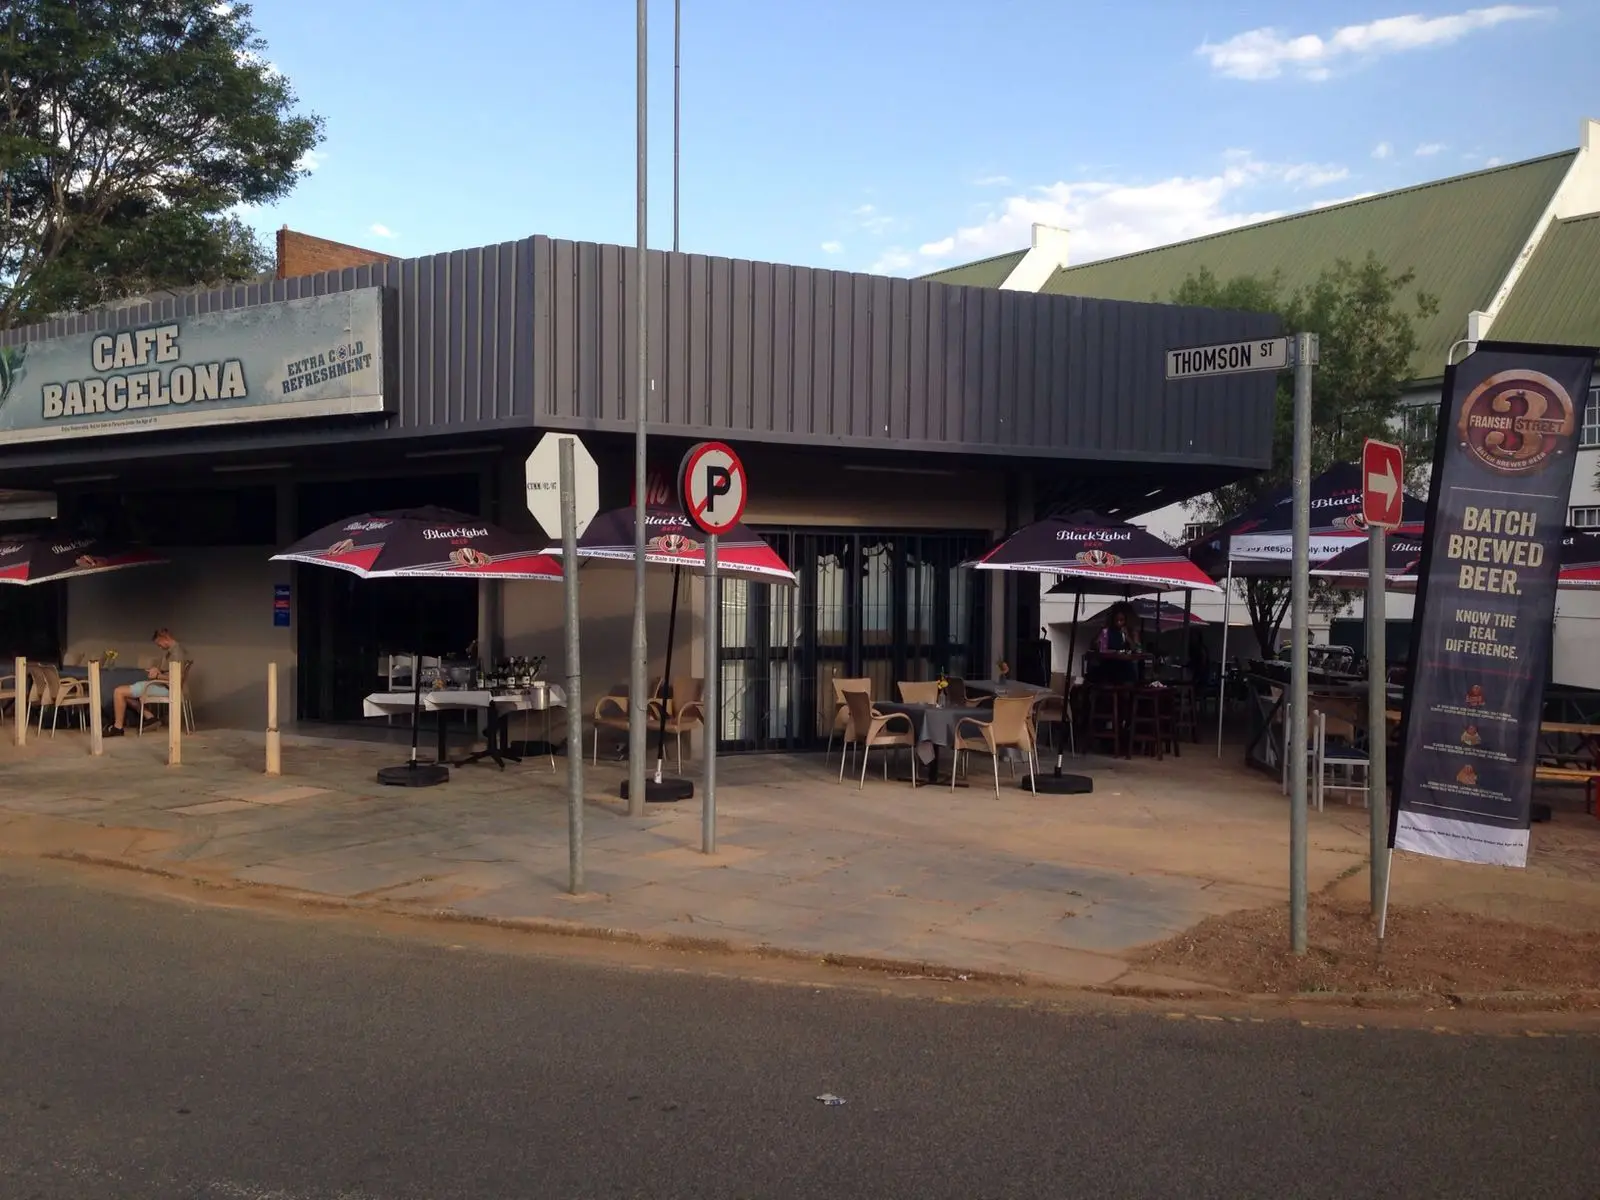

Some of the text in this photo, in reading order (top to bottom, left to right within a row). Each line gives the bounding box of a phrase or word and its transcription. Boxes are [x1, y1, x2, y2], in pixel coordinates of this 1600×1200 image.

[91, 324, 181, 372] CAFE
[1173, 345, 1251, 375] THOMSON
[1260, 342, 1274, 357] ST
[282, 353, 372, 394] REFRESHMENT
[287, 353, 326, 377] EXTRA
[42, 360, 248, 419] BARCELONA
[1469, 415, 1565, 434] FRANSEN STREET
[1496, 459, 1527, 468] BREWED
[706, 465, 731, 512] P
[1311, 494, 1361, 508] Black
[1463, 506, 1537, 537] BATCH
[423, 527, 489, 540] Black Label
[1056, 530, 1132, 541] Black Label
[1323, 545, 1339, 553] Not
[1447, 534, 1544, 568] BREWED
[1459, 565, 1522, 595] BEER.
[1456, 609, 1517, 628] KNOW THE
[1469, 626, 1498, 642] REAL
[1445, 638, 1519, 660] DIFFERENCE.
